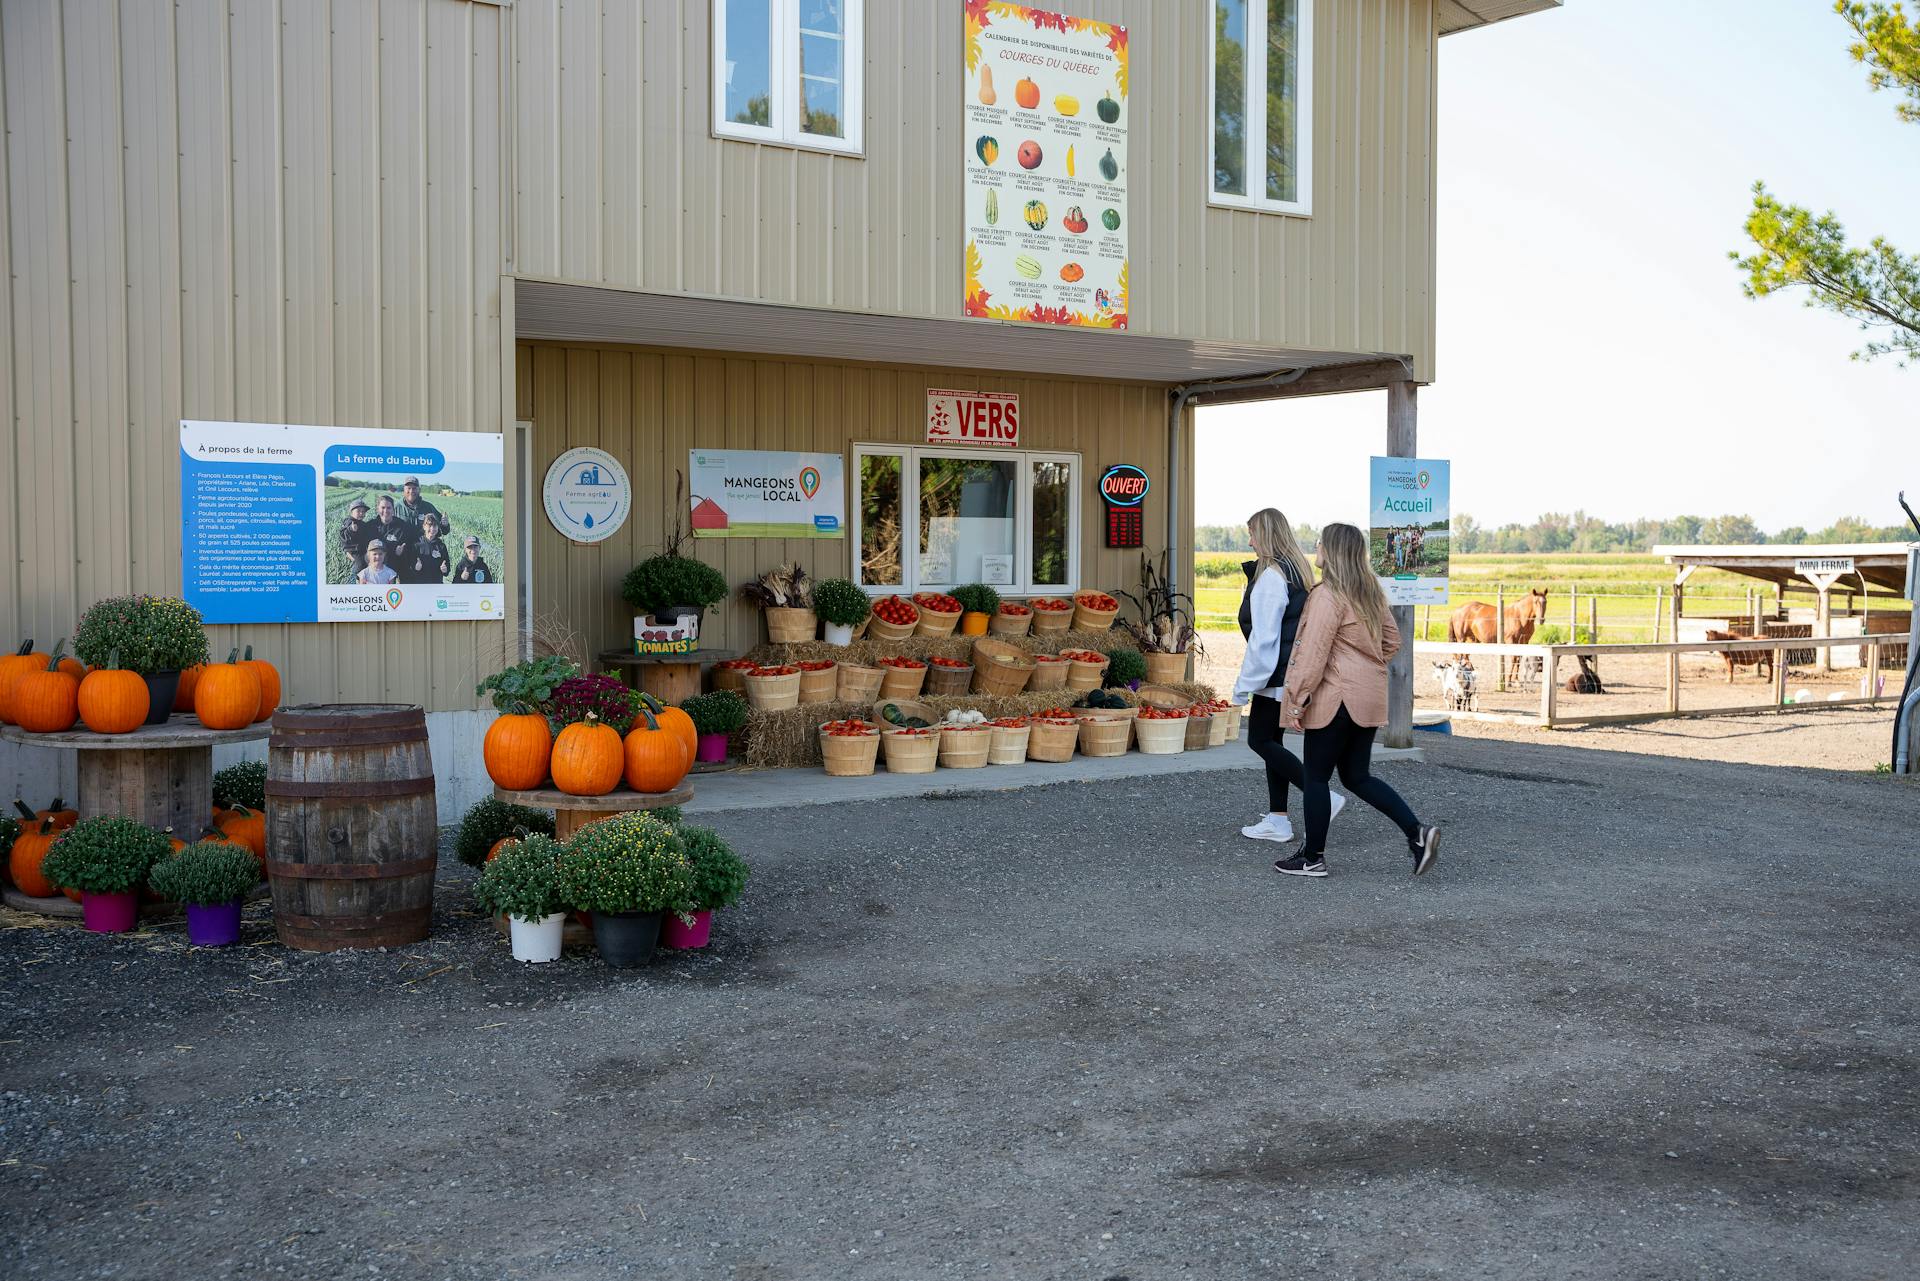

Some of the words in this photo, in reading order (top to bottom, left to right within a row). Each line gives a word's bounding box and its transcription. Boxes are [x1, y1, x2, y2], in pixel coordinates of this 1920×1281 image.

[985, 33, 1020, 44] CALENDRIER
[1030, 40, 1068, 52] DISPONIBILITÉ
[1081, 50, 1104, 60] VARIÉTÉS
[1000, 50, 1044, 66] COURGES
[1046, 58, 1060, 68] DU
[1062, 59, 1100, 76] QUÉBEC
[956, 400, 1017, 440] VERS
[199, 443, 206, 452] À
[208, 446, 240, 454] propos
[268, 447, 293, 455] ferme
[338, 454, 350, 463] La
[353, 454, 383, 464] ferme
[387, 455, 400, 464] du
[403, 456, 433, 466] Barbu
[724, 477, 795, 489] MANGEONS
[1104, 477, 1146, 494] OUVERT
[763, 490, 800, 502] LOCAL
[1384, 497, 1432, 512] Accueil
[1800, 561, 1818, 570] MINI
[1822, 560, 1849, 570] FERME
[637, 640, 688, 653] TOMATES
